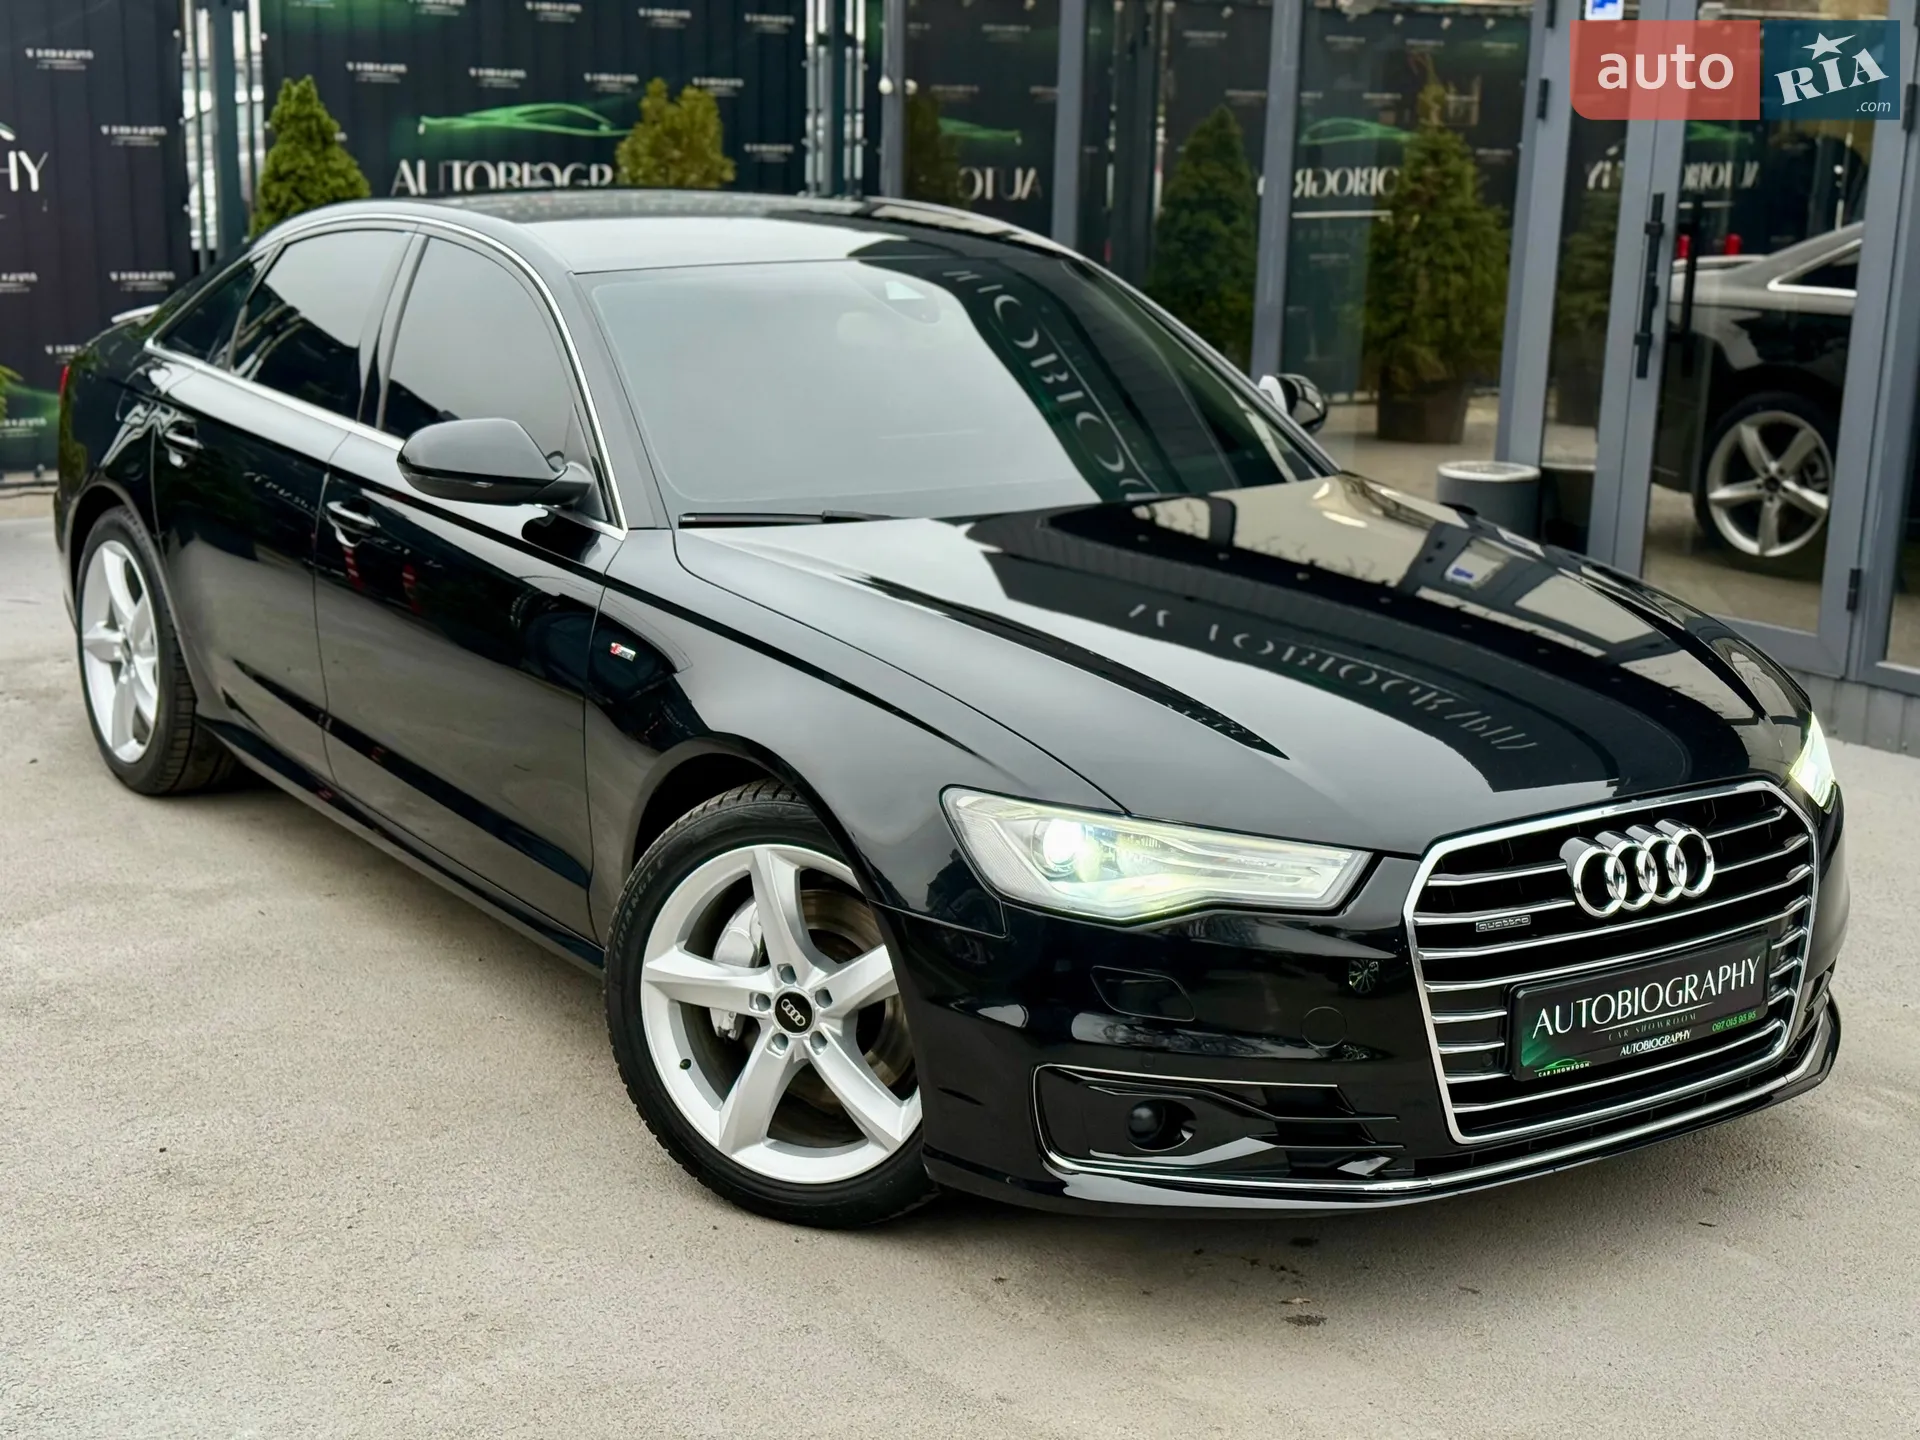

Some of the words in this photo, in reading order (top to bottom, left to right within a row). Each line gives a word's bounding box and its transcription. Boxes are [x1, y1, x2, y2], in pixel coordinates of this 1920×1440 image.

[1478, 916, 1529, 932] quattro
[1532, 955, 1761, 1040] AUTOBIOGRAPHY
[1711, 1020, 1726, 1032] 097
[1725, 1015, 1738, 1028] 015
[1608, 1028, 1630, 1042] CAR
[1619, 1028, 1693, 1057] AUTOBIOGRAPHY
